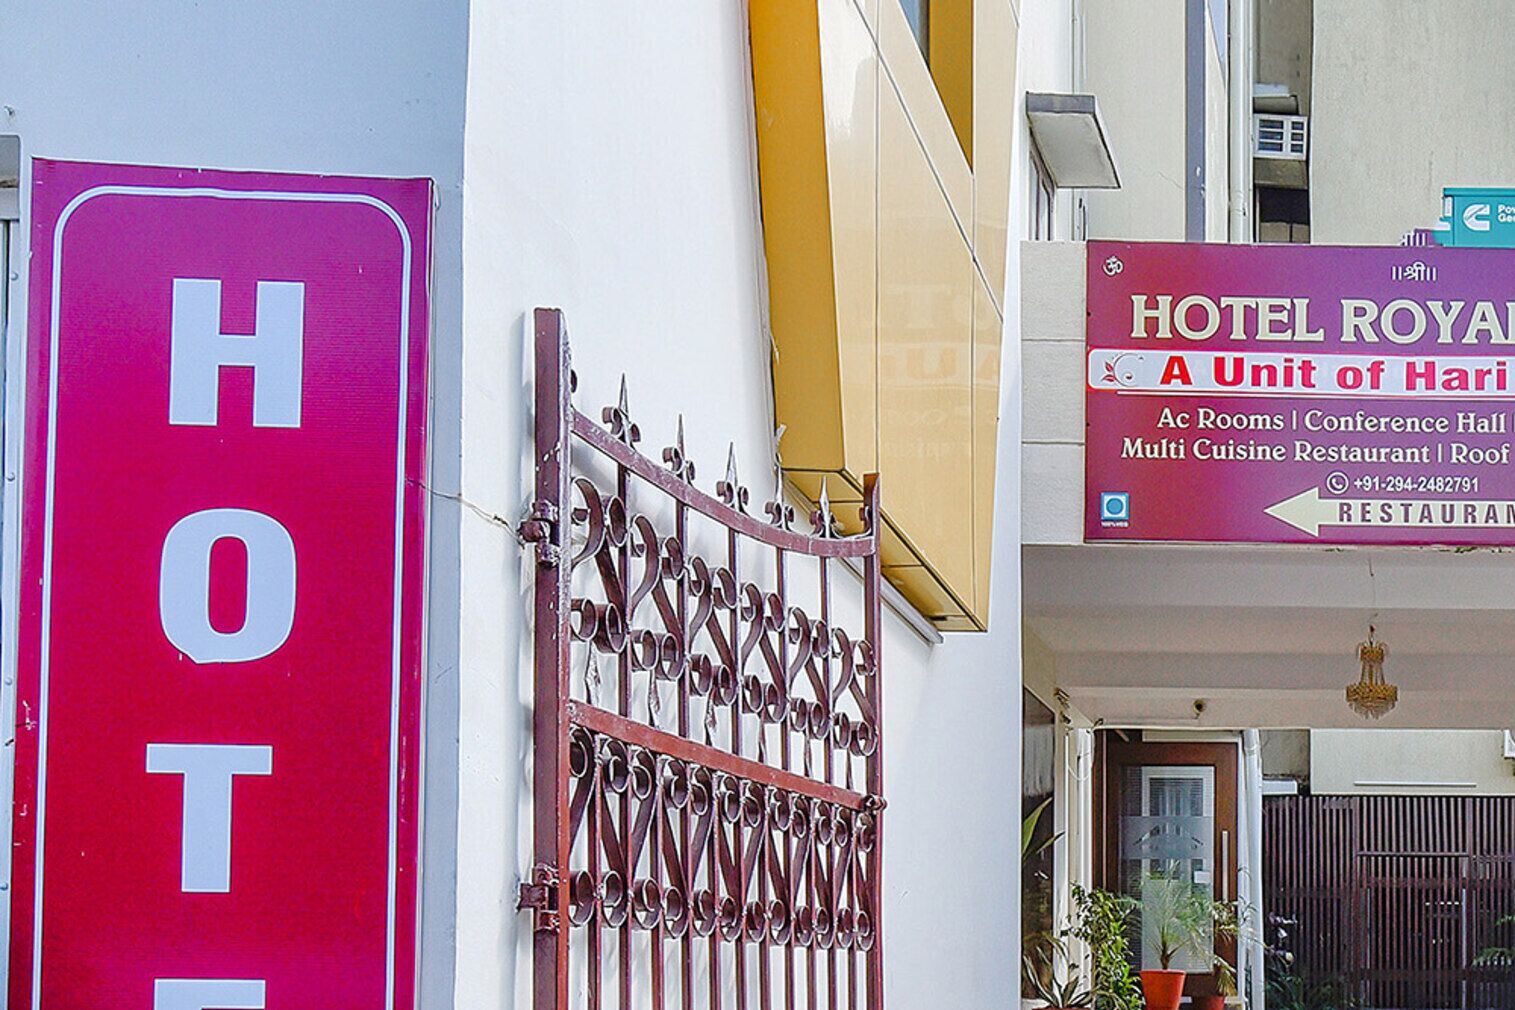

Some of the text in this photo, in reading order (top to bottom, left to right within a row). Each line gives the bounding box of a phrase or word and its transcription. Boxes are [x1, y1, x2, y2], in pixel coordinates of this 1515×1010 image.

[1130, 294, 1325, 342] HOTEL
[1160, 355, 1193, 385] A
[1213, 356, 1317, 388] Unit
[1336, 360, 1385, 390] of
[1405, 361, 1507, 391] Hari
[1157, 407, 1190, 428] Ac
[1197, 409, 1284, 430] Rooms
[1304, 410, 1449, 433] Conference
[1456, 412, 1506, 434] Hall
[1121, 437, 1186, 459] Multi
[1193, 438, 1286, 460] Cuisine
[1293, 440, 1431, 463] Restaurant
[1450, 443, 1511, 465] Roof
[1353, 475, 1479, 493] +91-294-2482791
